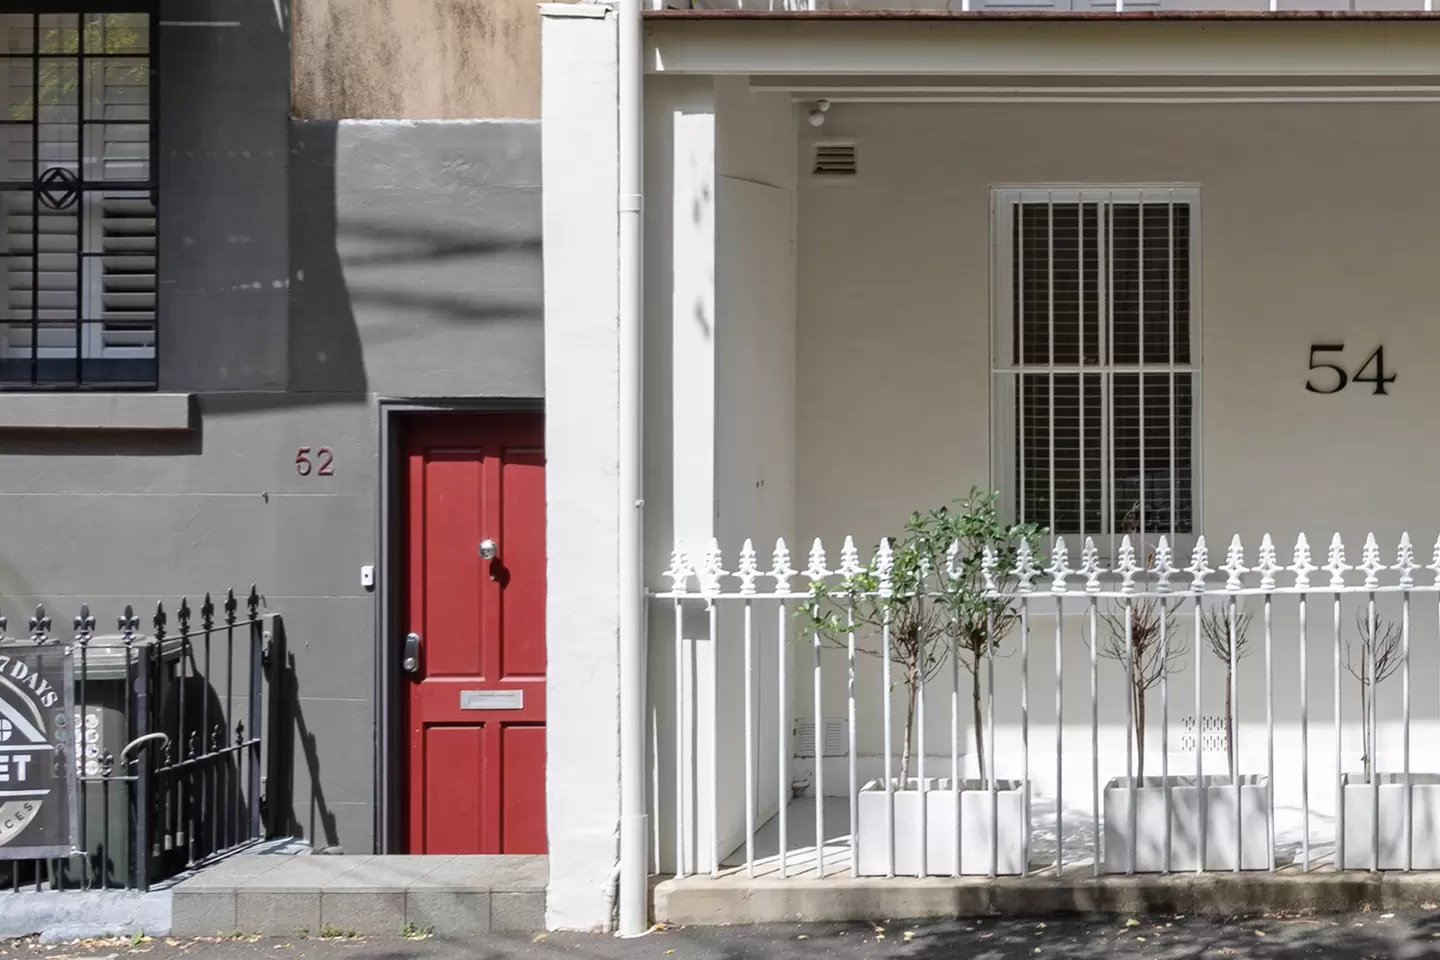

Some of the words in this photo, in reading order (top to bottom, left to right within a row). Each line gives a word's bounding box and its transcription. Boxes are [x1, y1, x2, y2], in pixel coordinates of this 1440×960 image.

[1305, 343, 1398, 396] 54
[295, 446, 334, 477] 52
[10, 660, 59, 708] DAYS
[0, 802, 34, 835] CES
